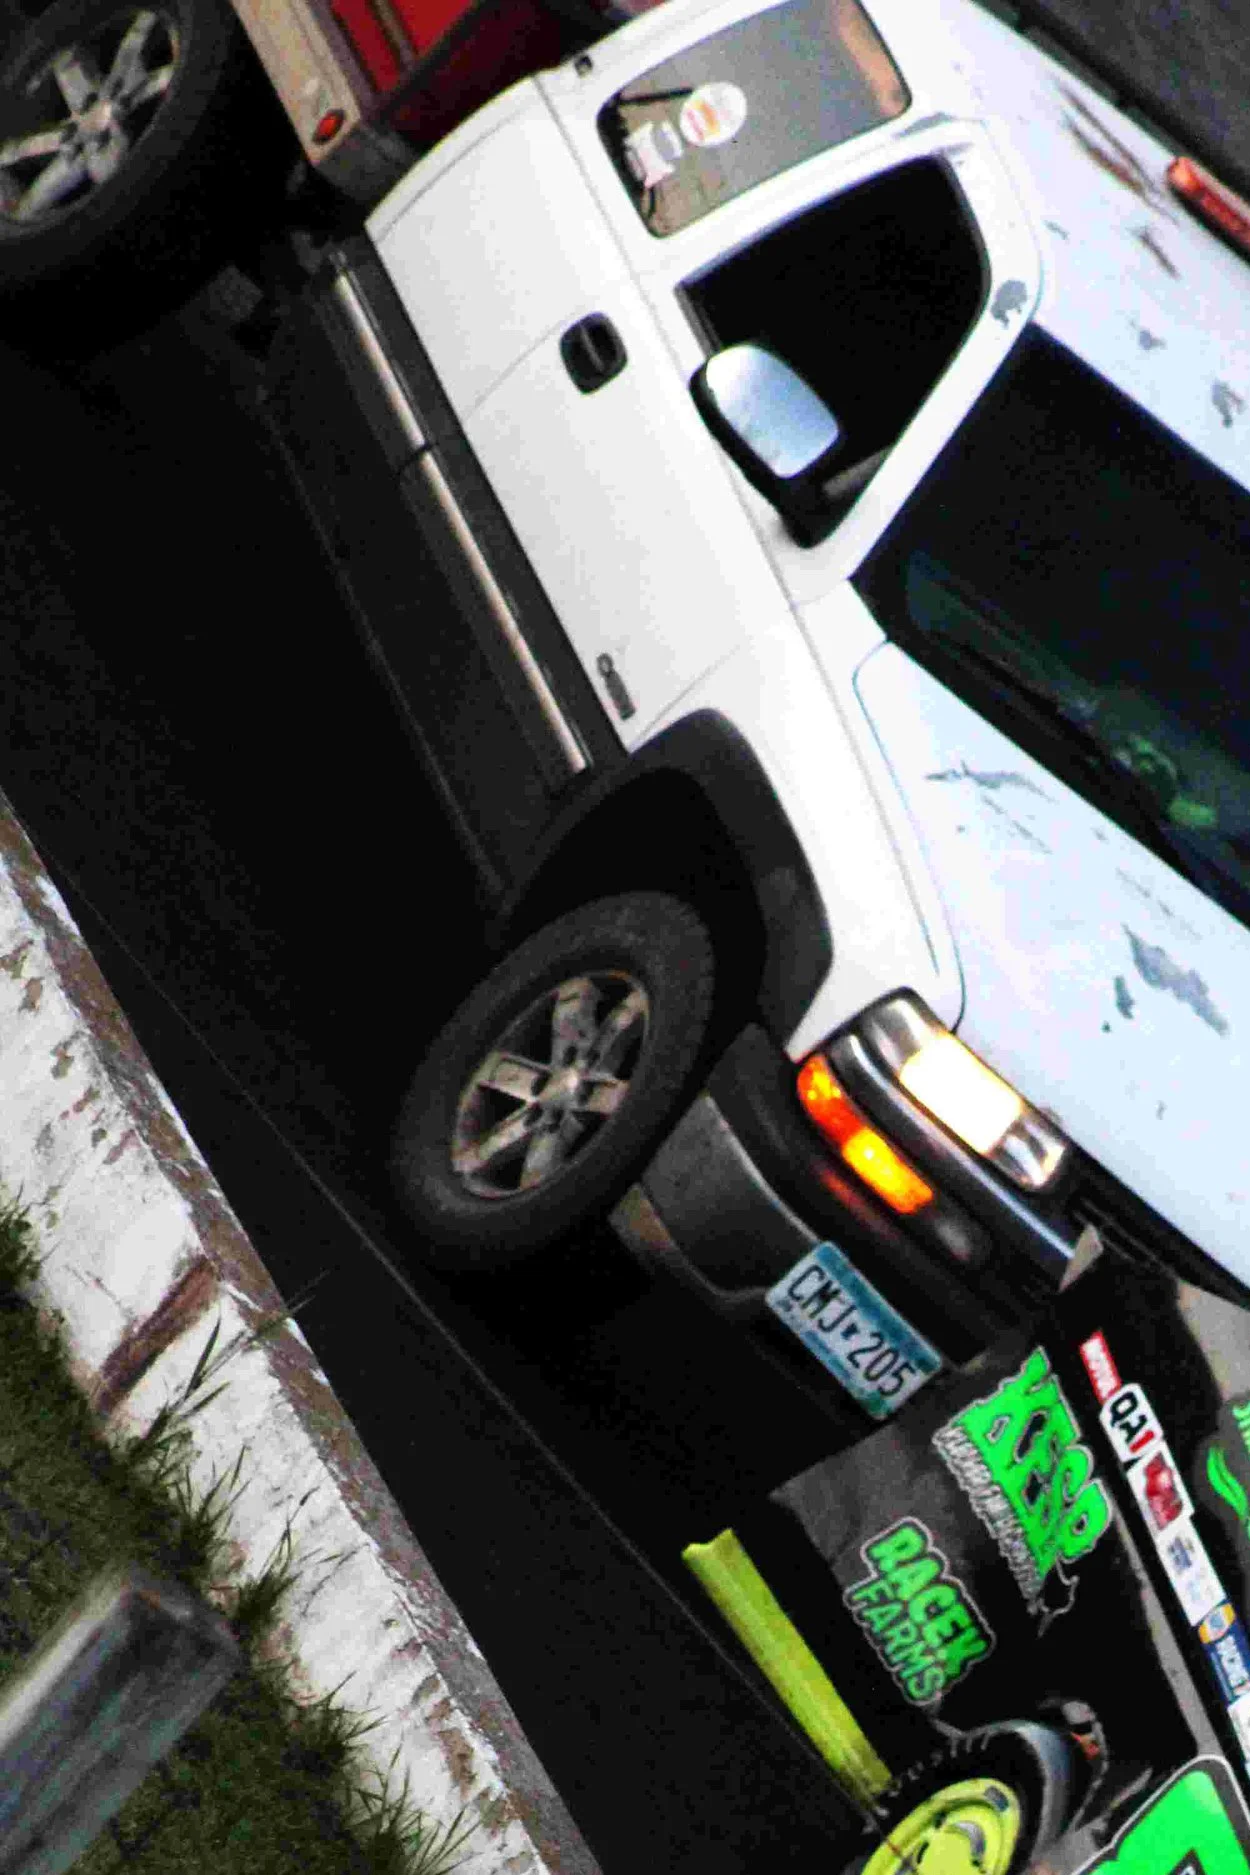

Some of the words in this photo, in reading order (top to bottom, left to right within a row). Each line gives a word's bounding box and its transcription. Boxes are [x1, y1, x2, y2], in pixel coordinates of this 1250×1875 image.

[788, 1264, 855, 1334] CMJ
[846, 1331, 914, 1400] 205
[1105, 1389, 1153, 1455] QA1
[850, 1577, 948, 1700] FARMS
[865, 1522, 988, 1681] RACEK
